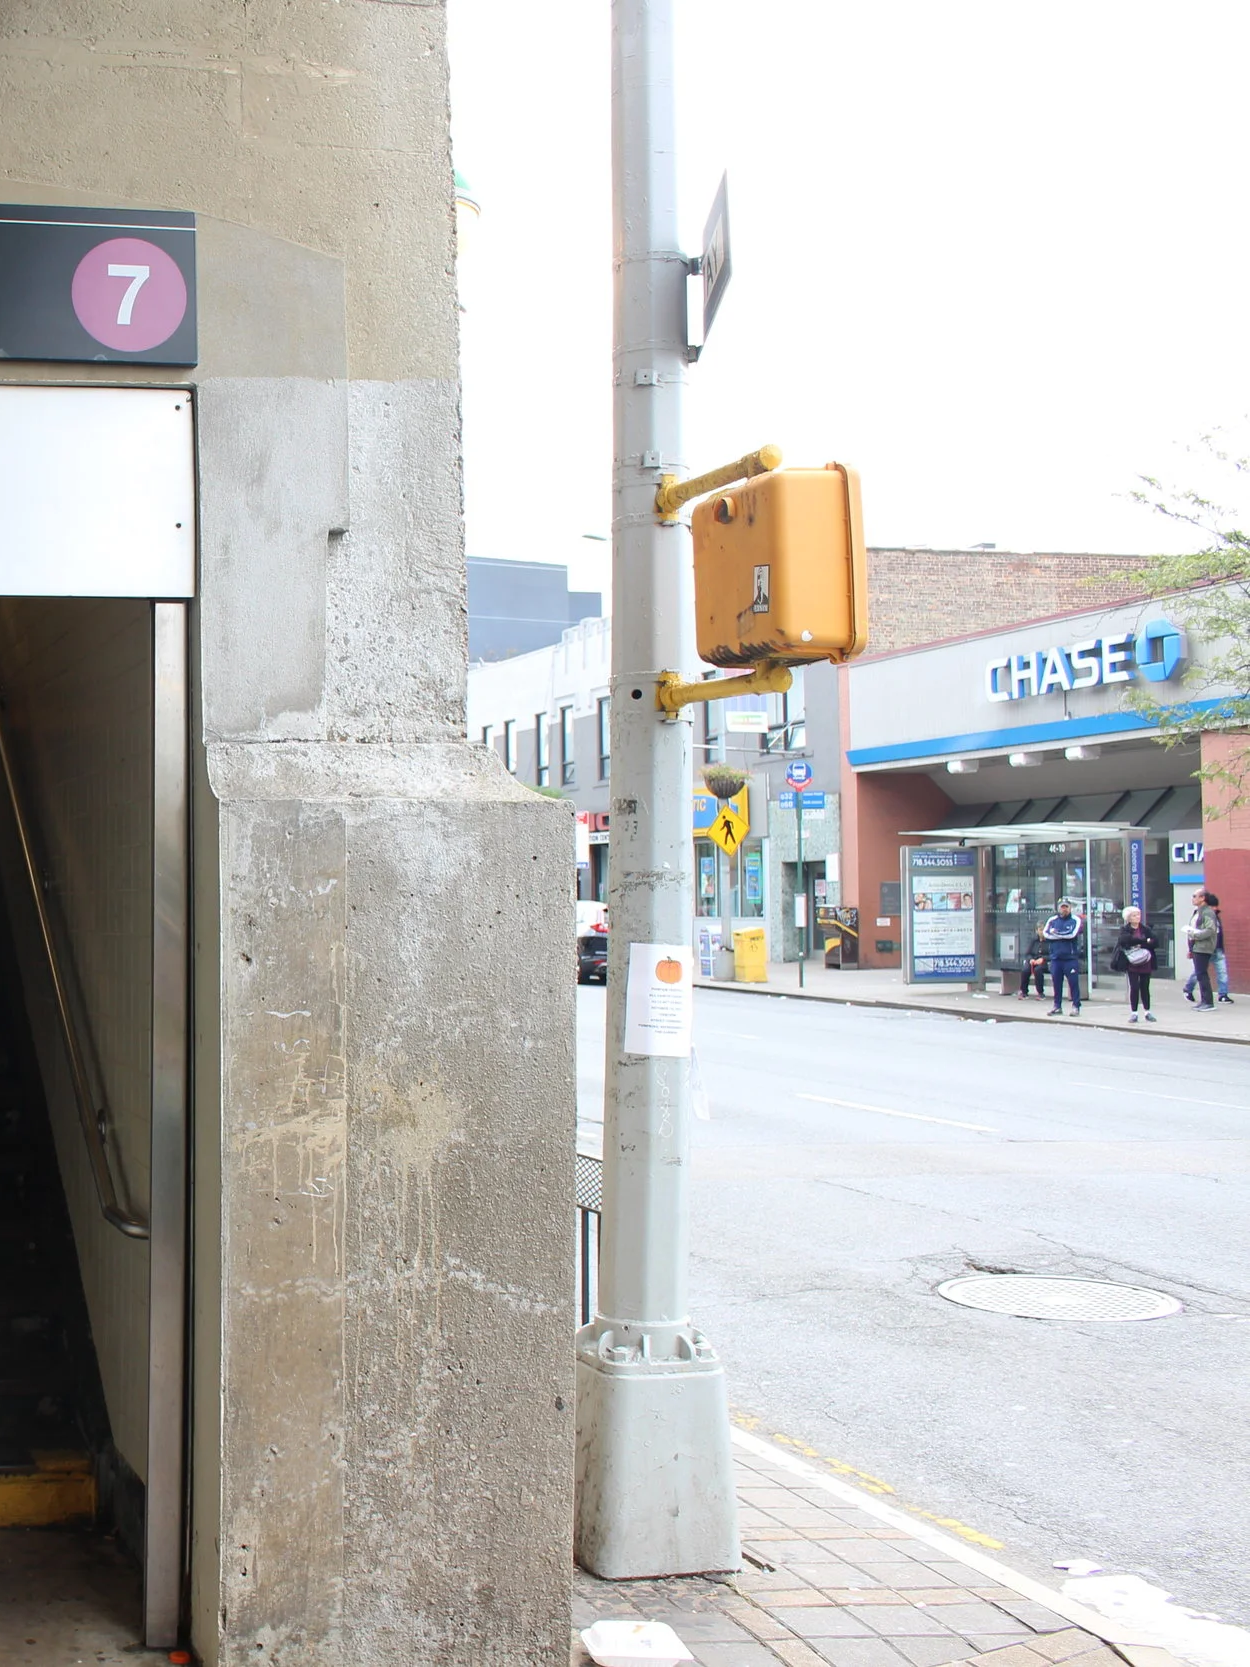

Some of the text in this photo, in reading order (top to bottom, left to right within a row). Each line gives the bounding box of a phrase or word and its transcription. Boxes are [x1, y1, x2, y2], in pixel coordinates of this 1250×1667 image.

[106, 263, 150, 326] 7
[985, 633, 1135, 703] CHASE
[1131, 842, 1139, 872] Queens
[1131, 873, 1139, 892] Blvd
